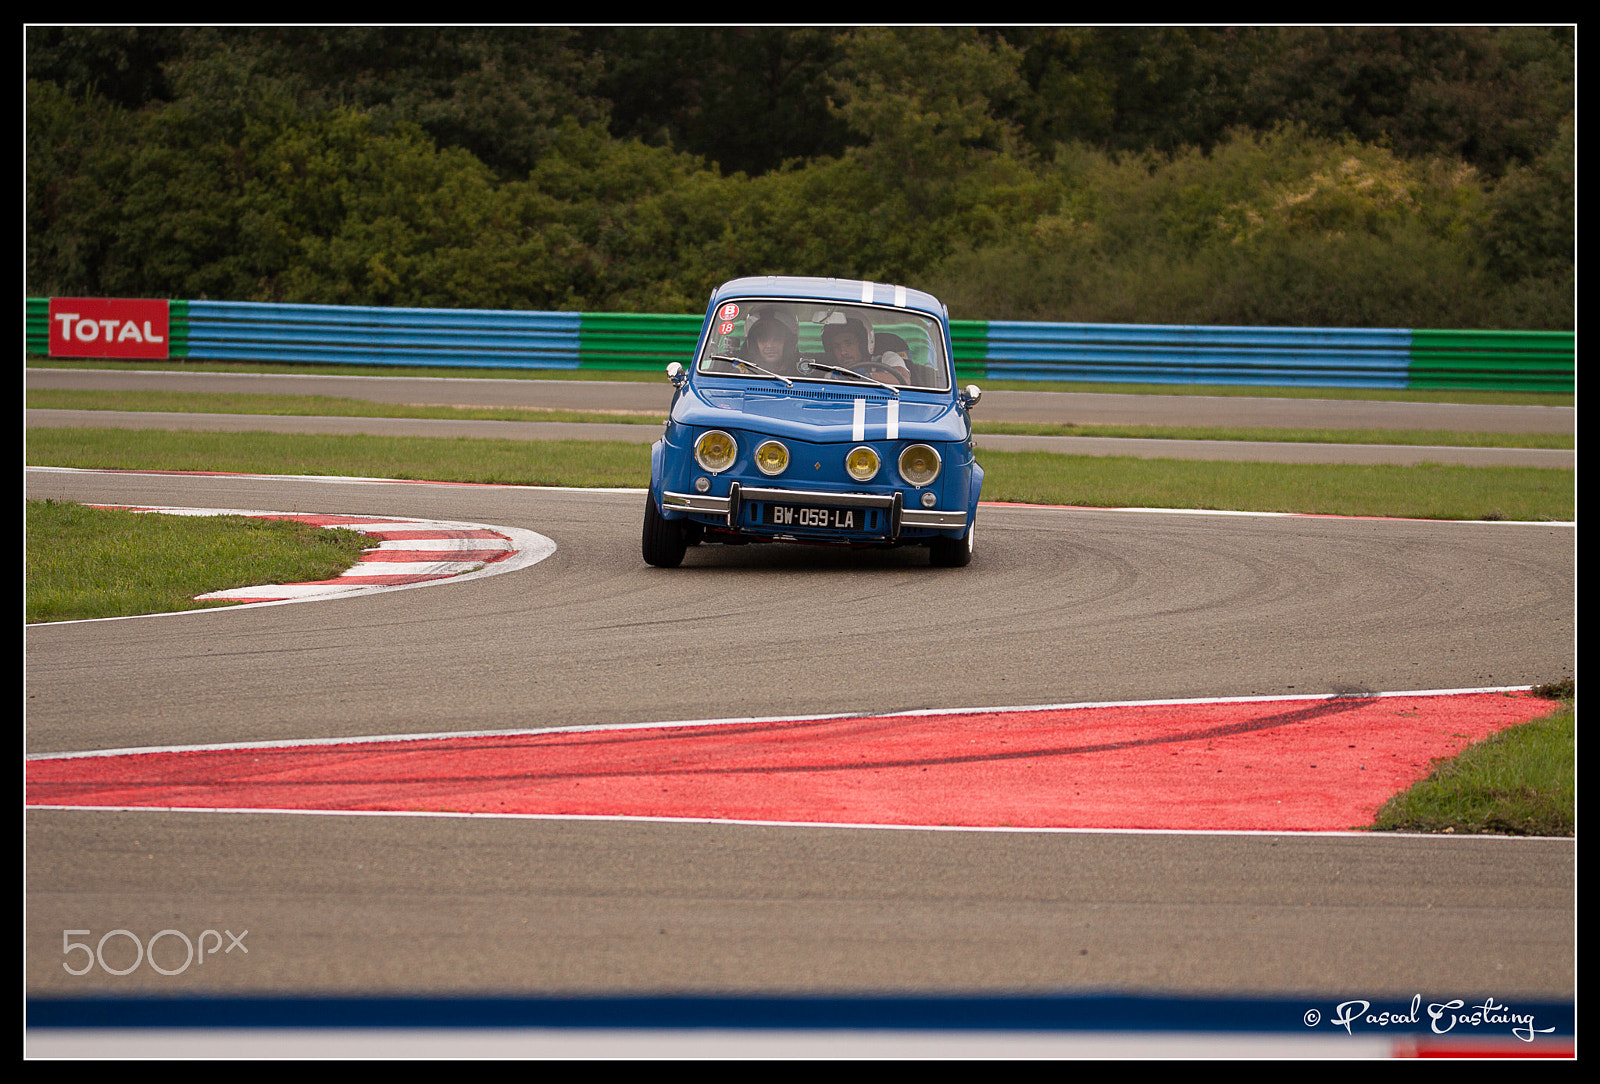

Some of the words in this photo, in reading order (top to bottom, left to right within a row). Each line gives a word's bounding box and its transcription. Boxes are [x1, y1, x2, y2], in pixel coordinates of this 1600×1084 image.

[725, 305, 736, 315] B
[54, 313, 164, 343] TOTAL
[721, 323, 733, 333] 18
